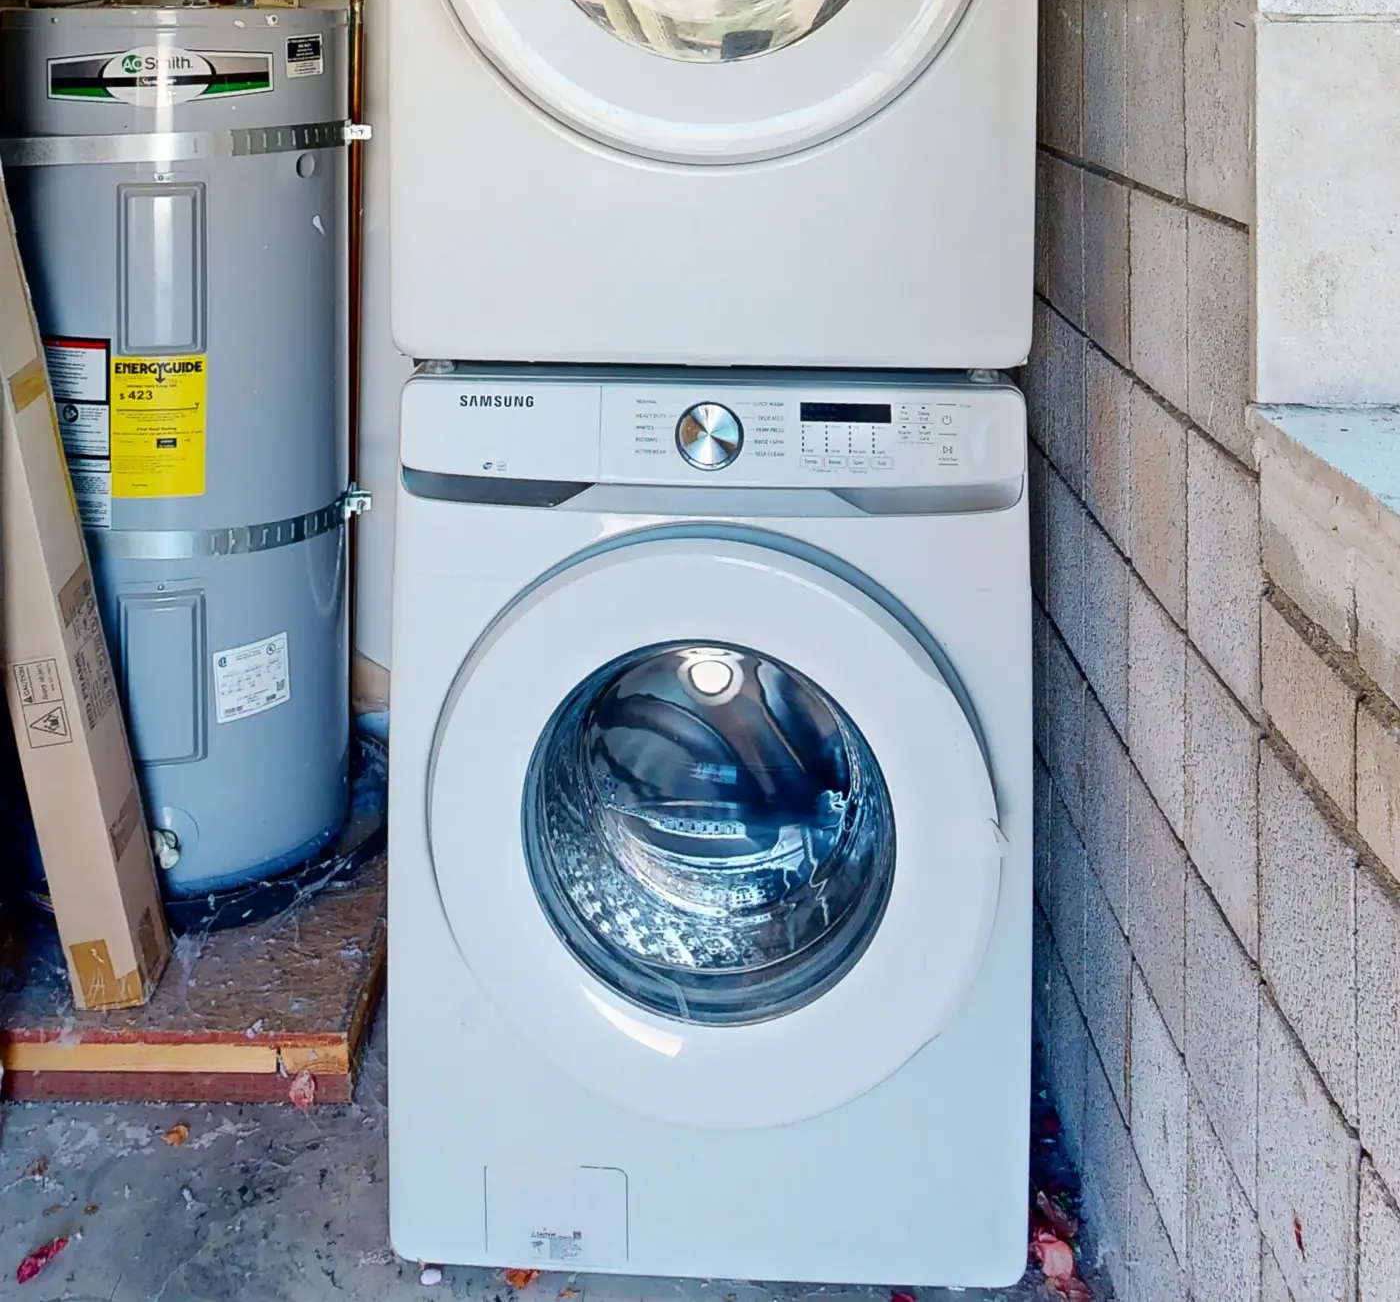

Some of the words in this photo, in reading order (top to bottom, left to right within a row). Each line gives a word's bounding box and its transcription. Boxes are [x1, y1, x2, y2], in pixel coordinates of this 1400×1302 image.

[114, 361, 203, 380] ENERGYGUIDE
[119, 393, 125, 401] $
[128, 390, 153, 400] 423
[460, 395, 535, 407] SAMSUNG
[19, 666, 31, 696] CAUTION
